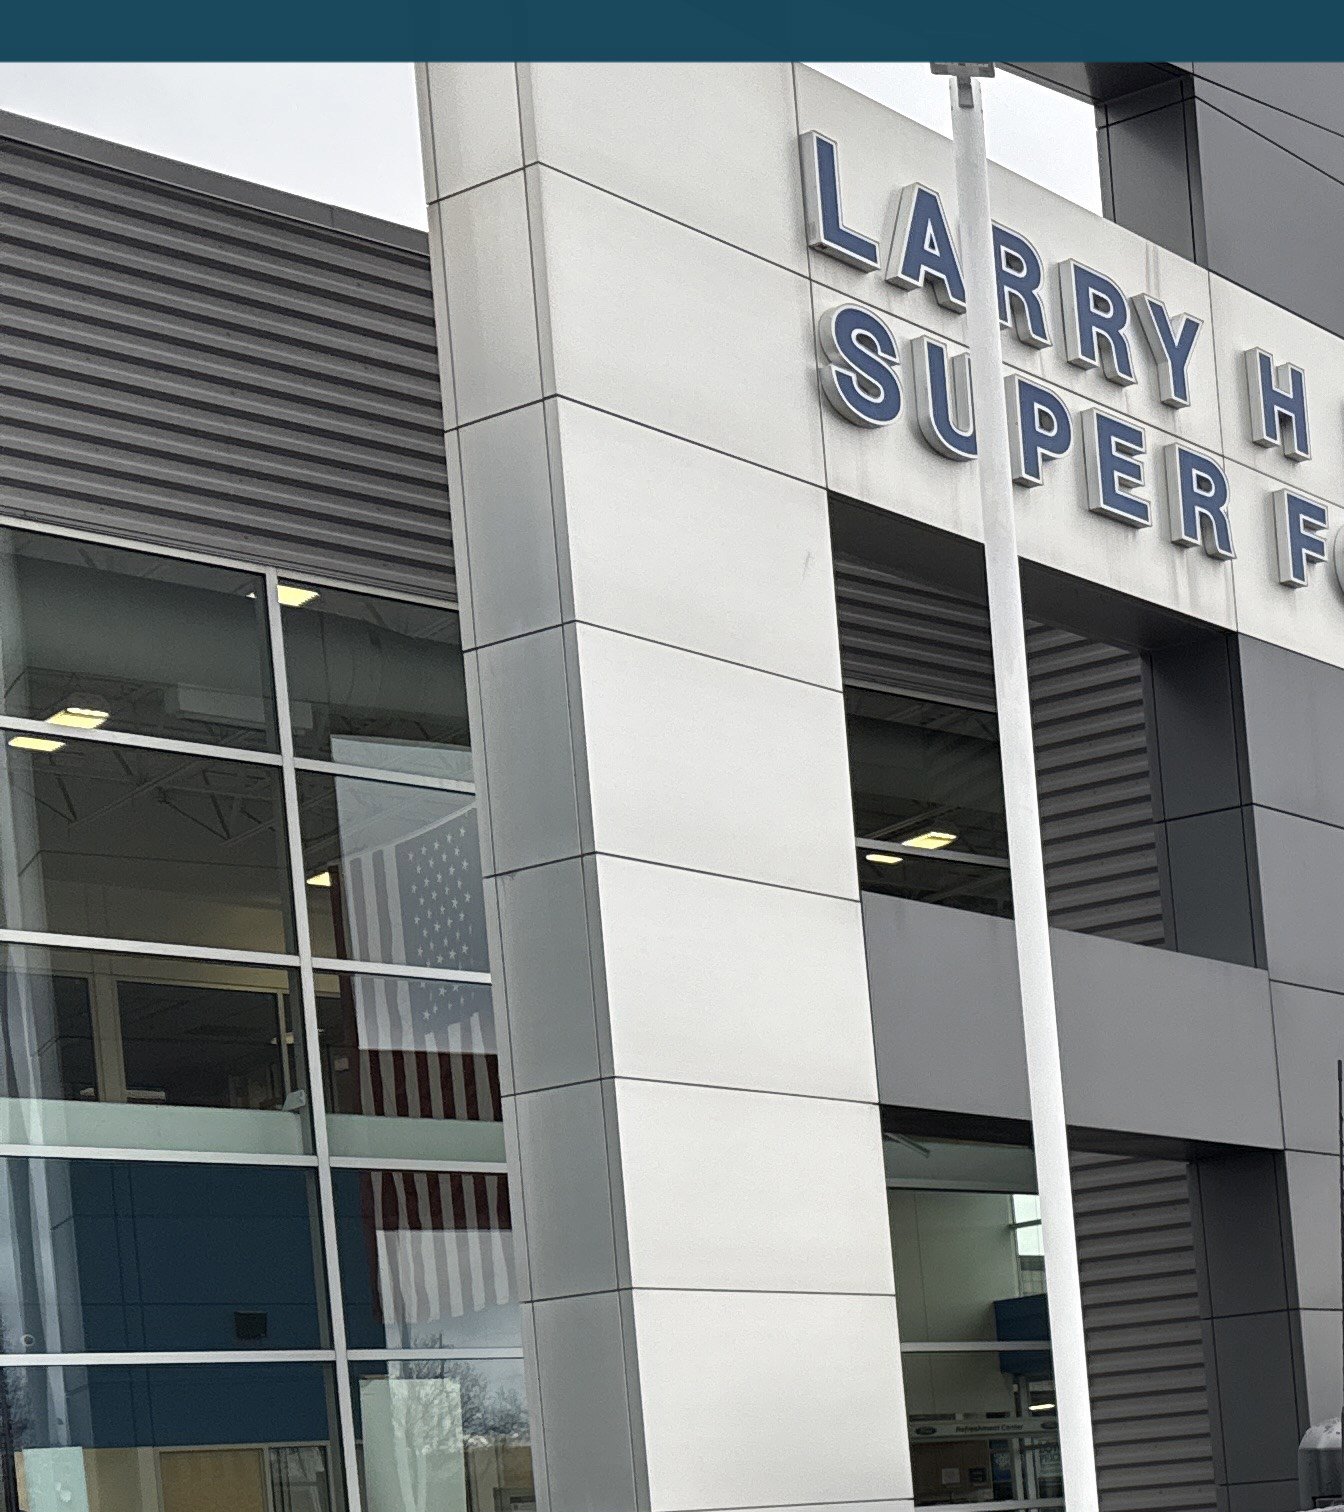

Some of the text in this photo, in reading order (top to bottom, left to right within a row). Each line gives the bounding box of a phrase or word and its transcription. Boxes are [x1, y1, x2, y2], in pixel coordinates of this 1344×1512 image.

[802, 130, 1204, 409] LARRY
[1244, 346, 1312, 462] H
[819, 302, 1237, 562] SUPER
